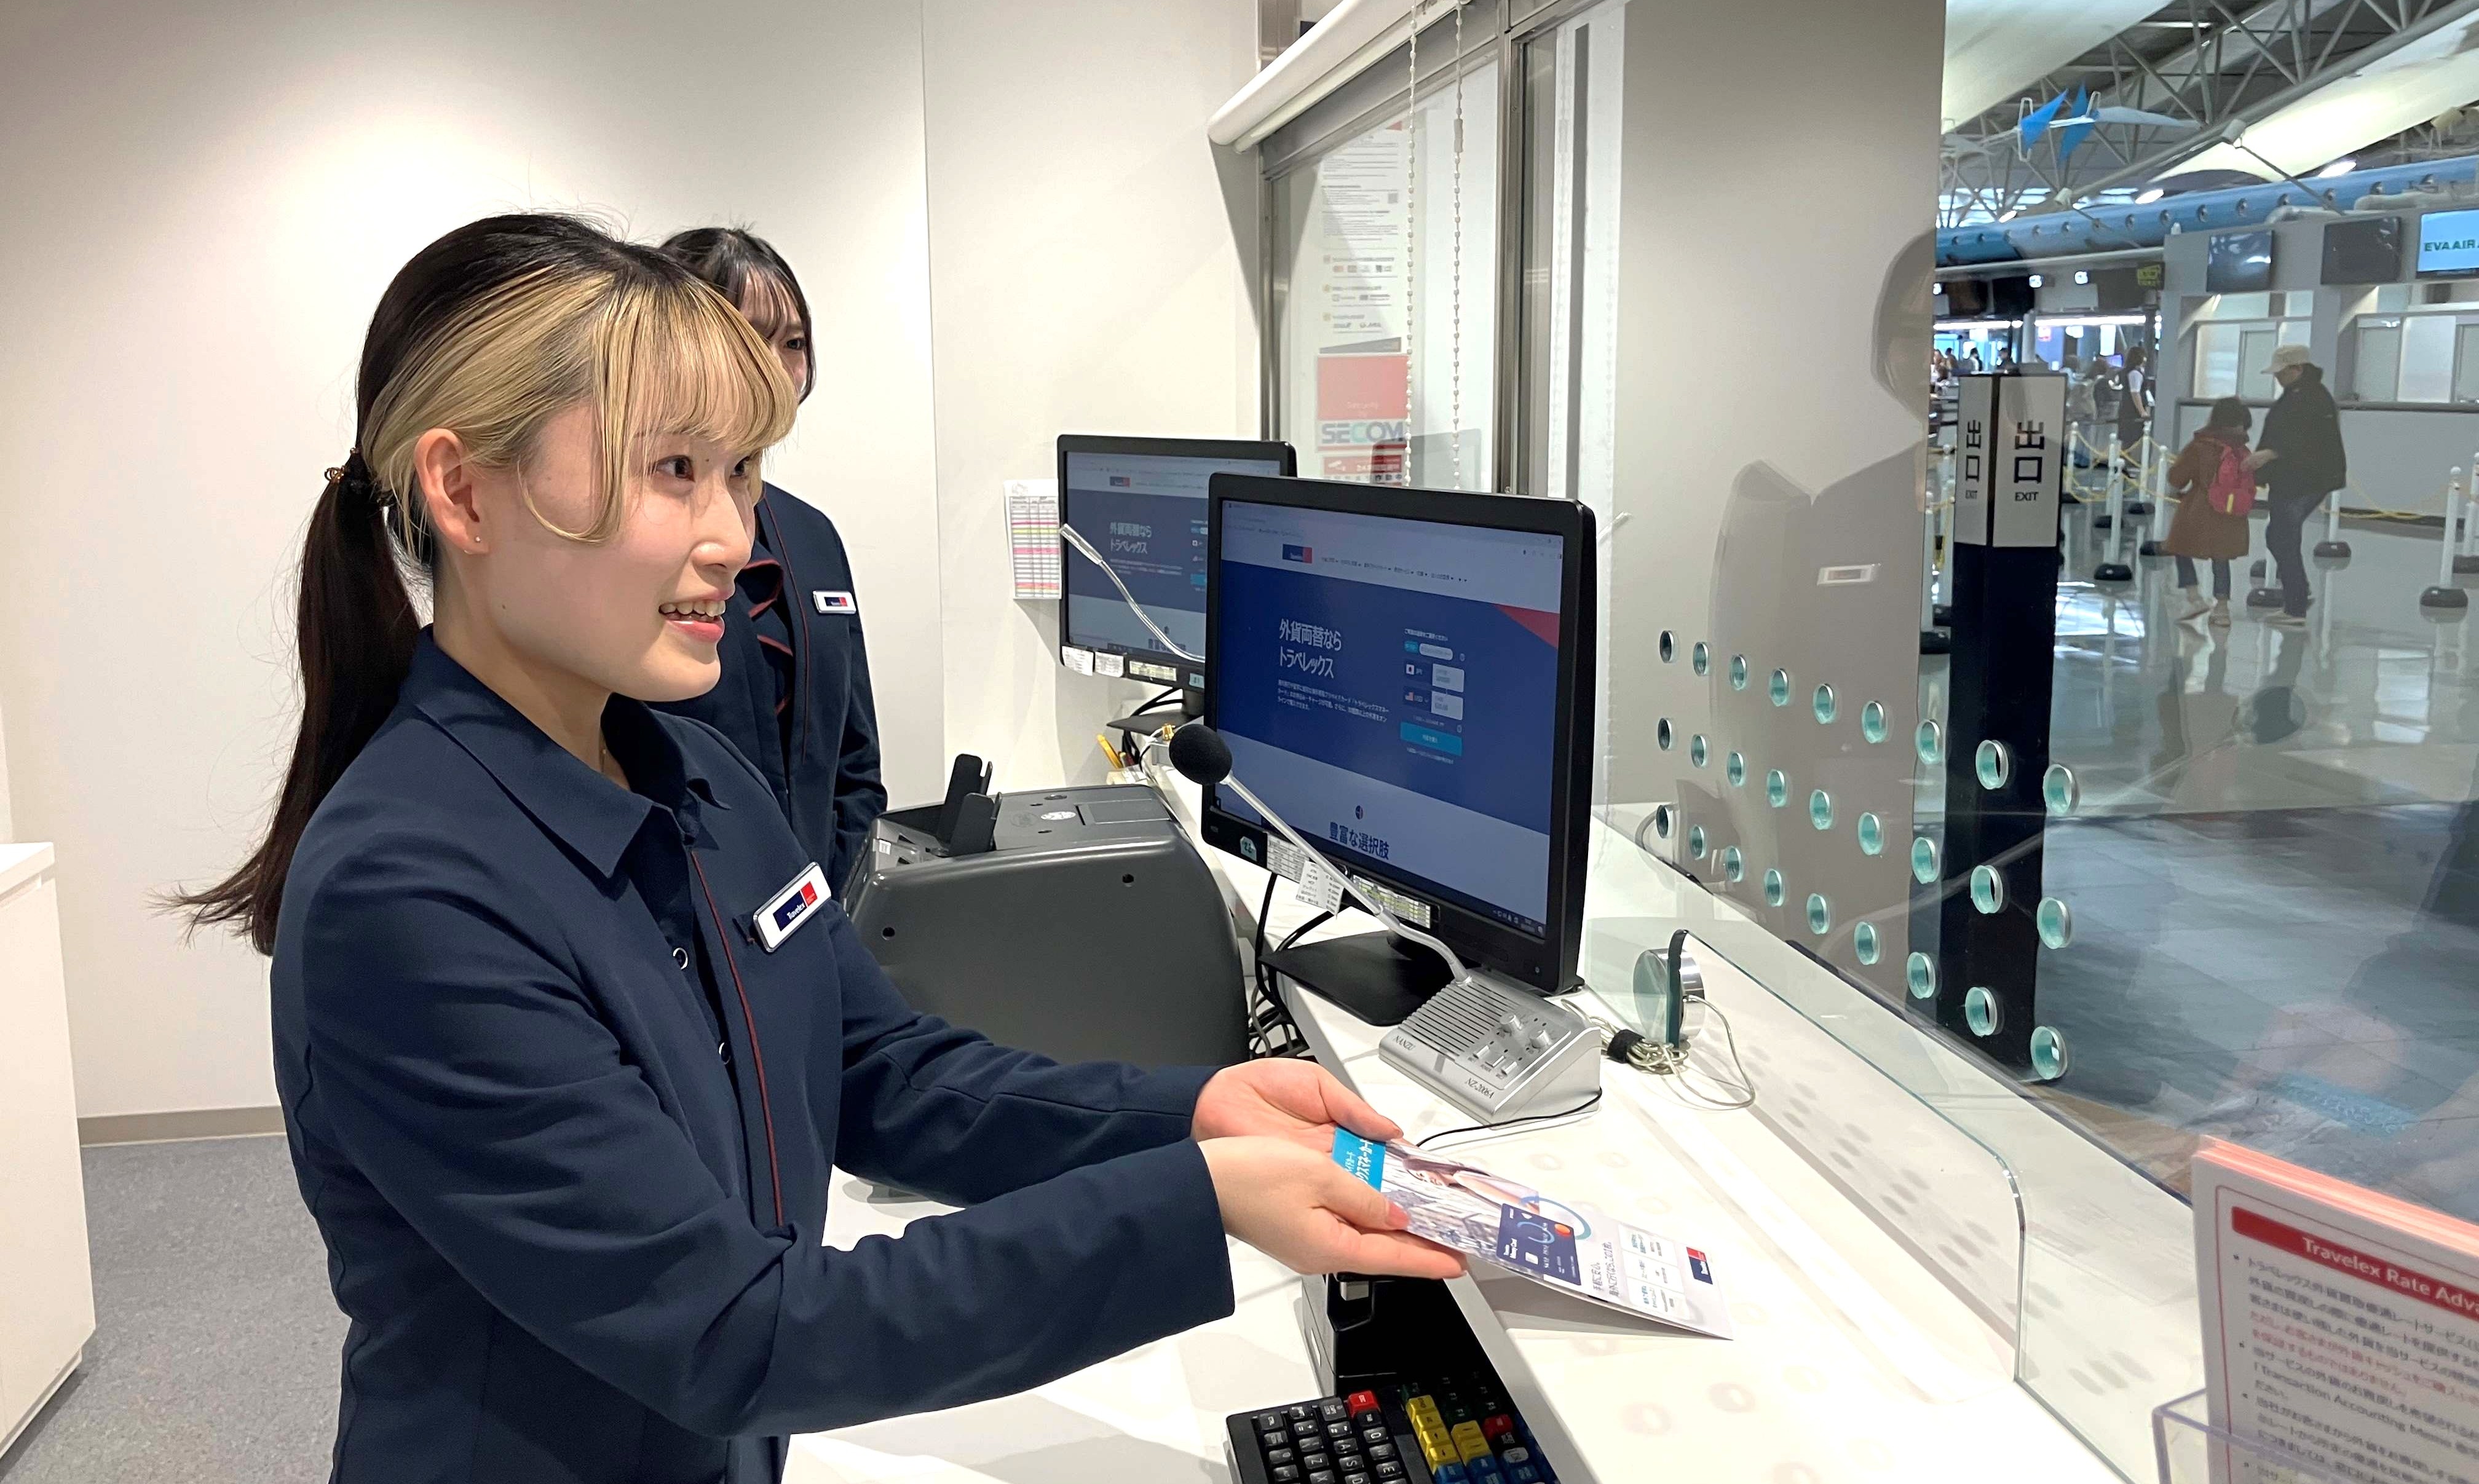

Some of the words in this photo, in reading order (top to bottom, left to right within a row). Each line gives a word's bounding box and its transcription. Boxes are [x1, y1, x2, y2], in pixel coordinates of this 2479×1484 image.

[1322, 421, 1404, 444] SECOM
[1966, 419, 1982, 483] 出口
[2014, 419, 2045, 484] 出口
[2015, 491, 2039, 502] EXIT
[1279, 618, 1342, 652] 外貨両替なら
[1279, 646, 1334, 679] トラベレックス
[1329, 821, 1390, 861] 豊富な選択肢
[786, 902, 806, 920] Travelex
[2302, 1236, 2381, 1278] Travelex
[2387, 1268, 2430, 1295] Rate
[1346, 1459, 1358, 1467] S
[1383, 1466, 1395, 1475] E
